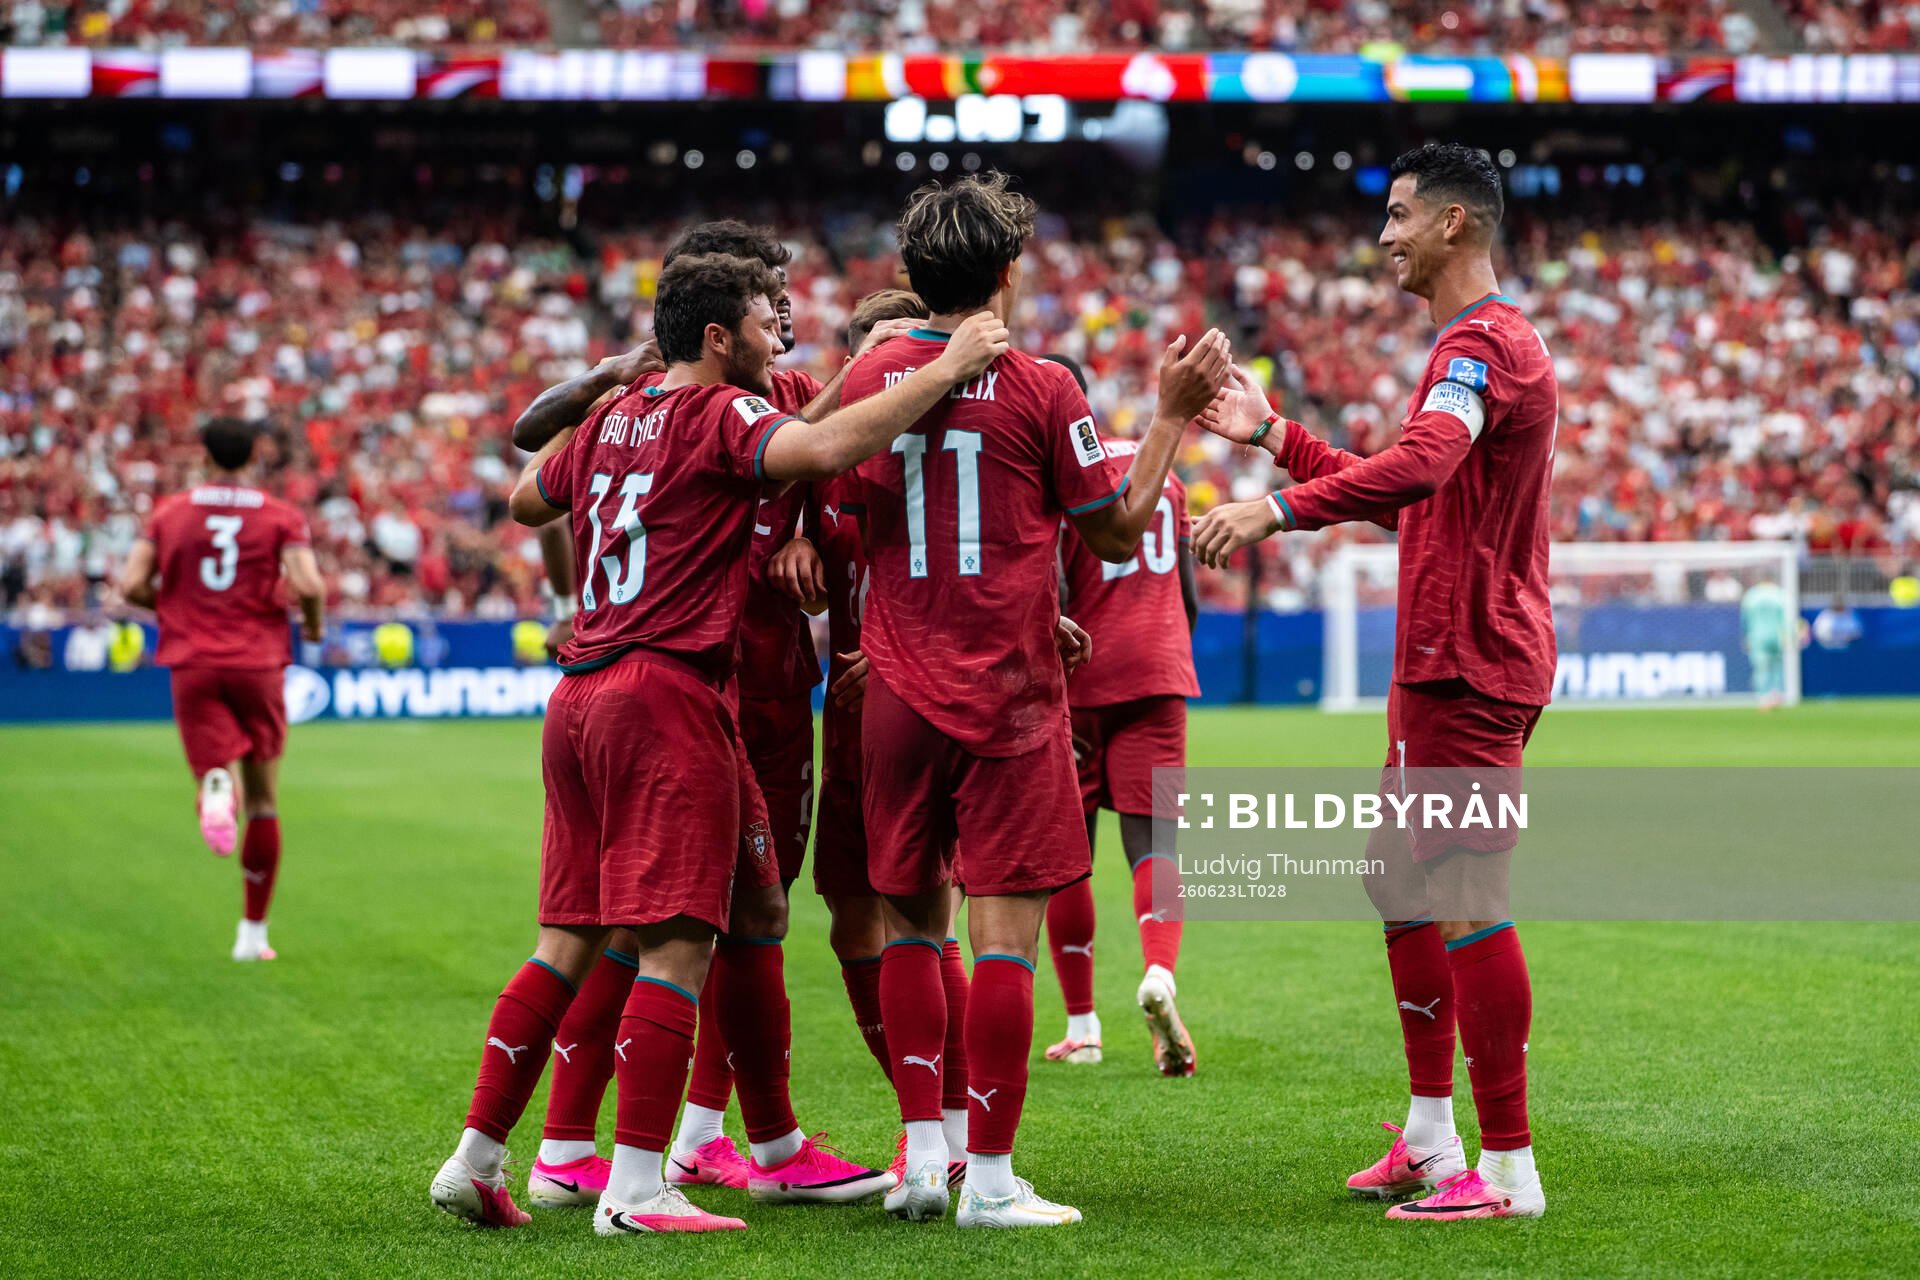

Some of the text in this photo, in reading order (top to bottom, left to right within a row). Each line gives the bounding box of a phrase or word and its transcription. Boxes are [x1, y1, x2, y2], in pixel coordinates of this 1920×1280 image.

[891, 429, 982, 578] 11
[201, 514, 243, 592] 3
[334, 666, 564, 716] HYUNDA
